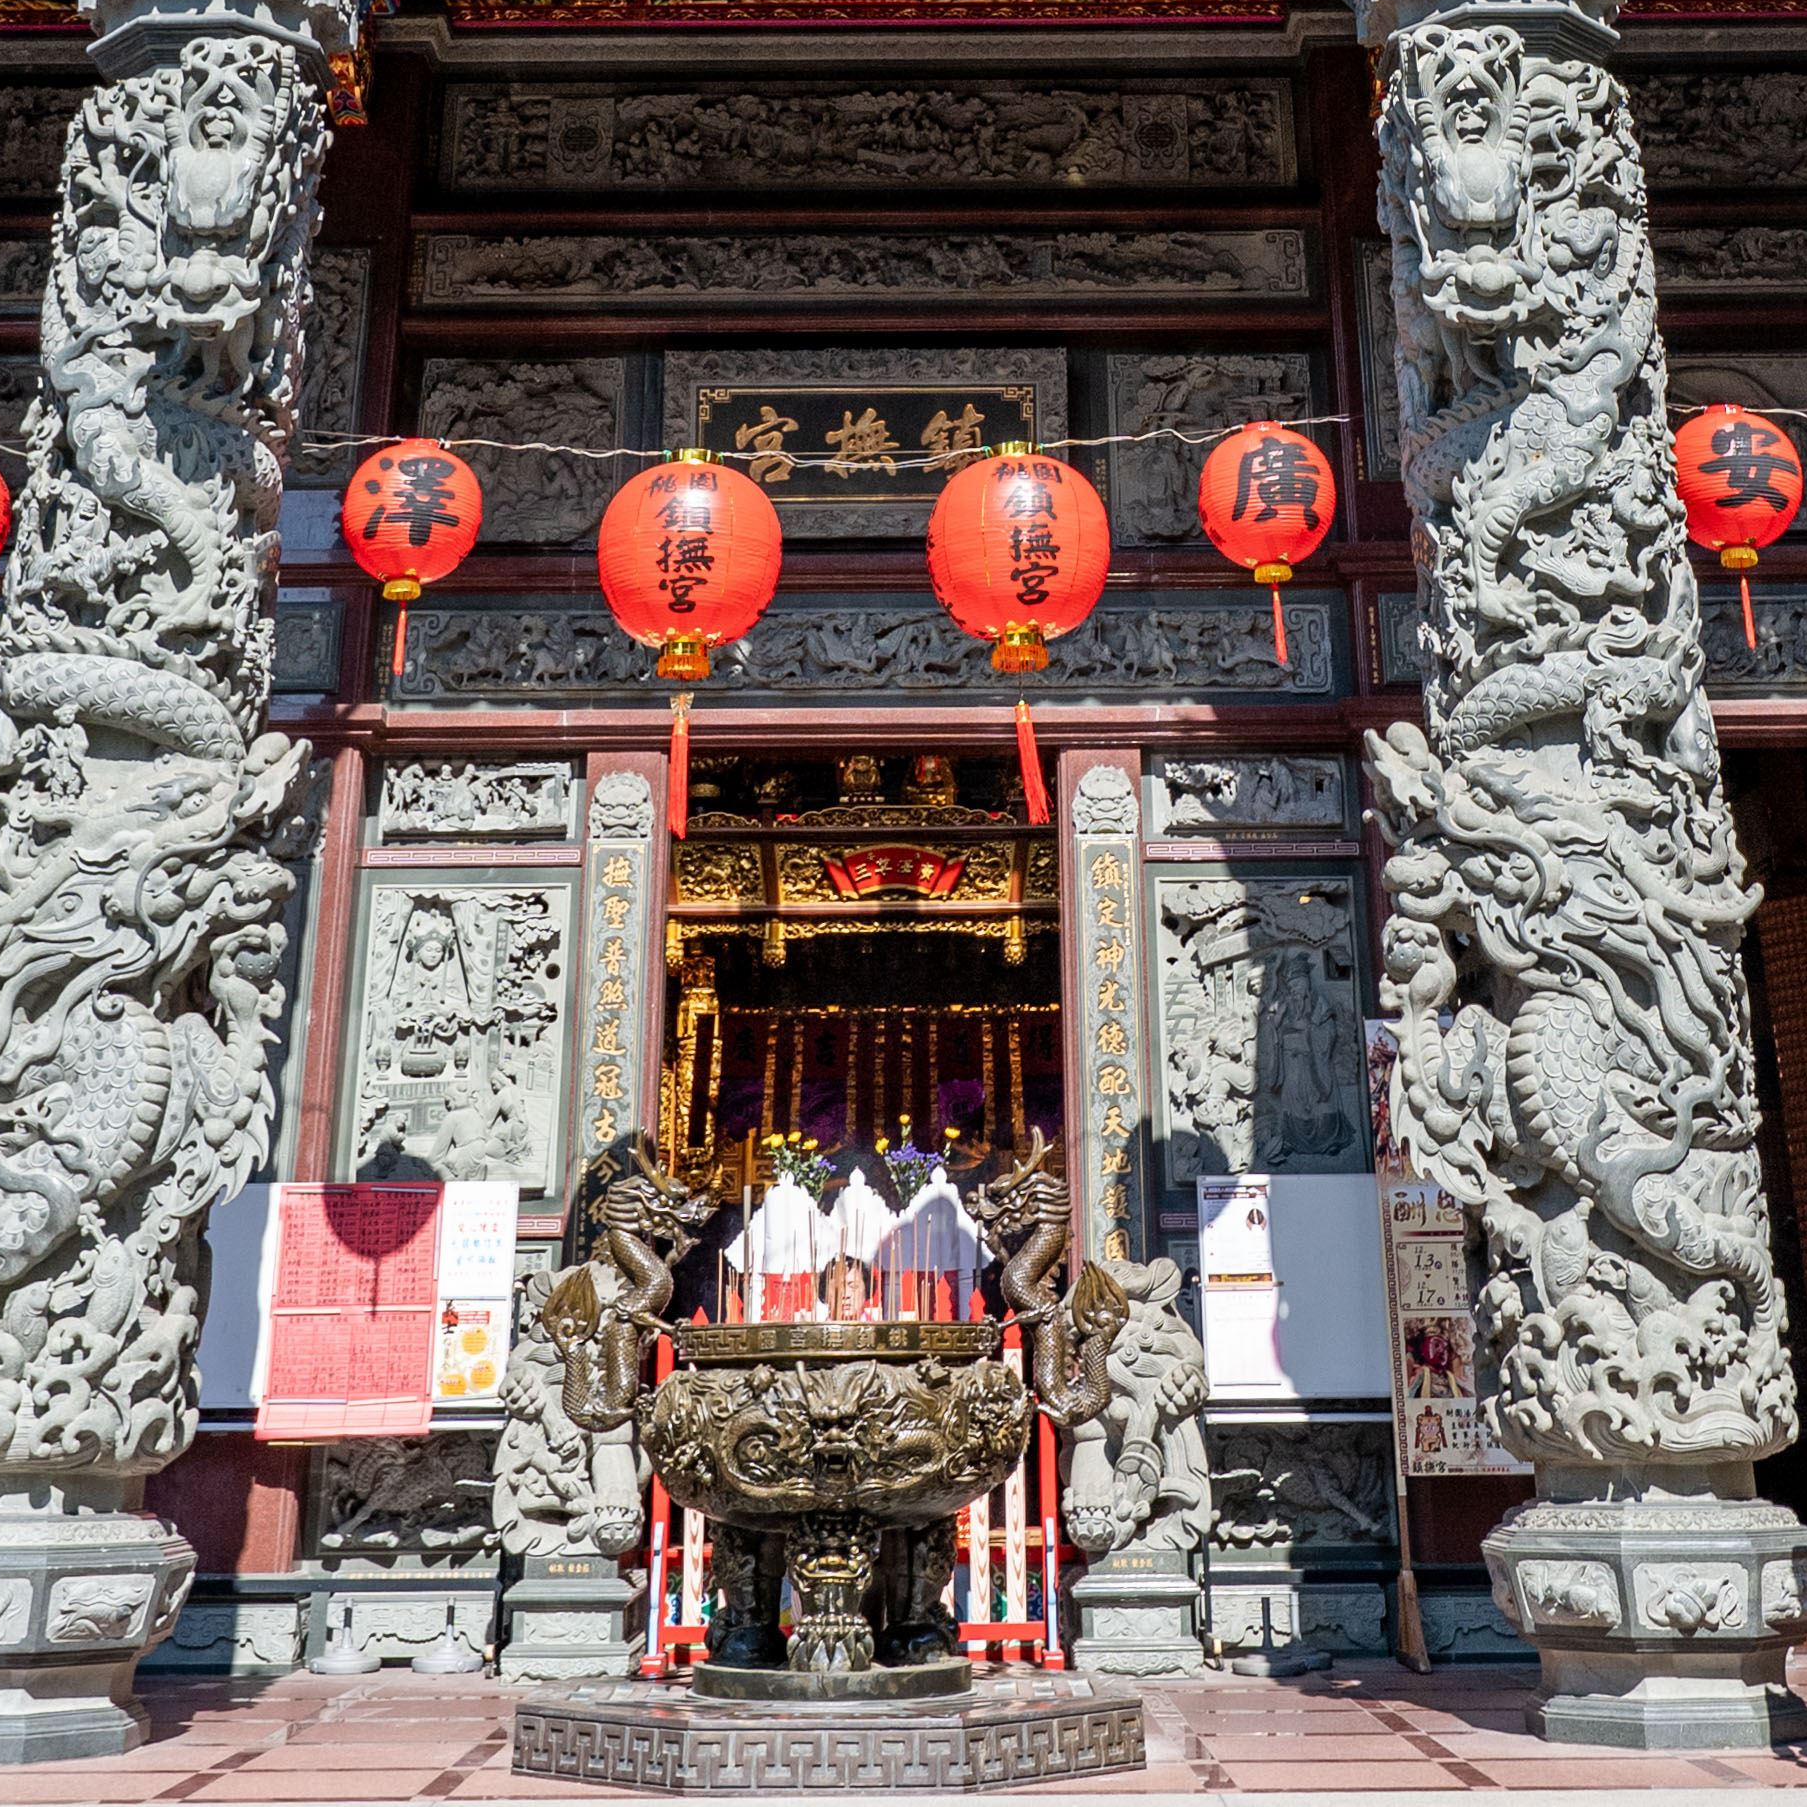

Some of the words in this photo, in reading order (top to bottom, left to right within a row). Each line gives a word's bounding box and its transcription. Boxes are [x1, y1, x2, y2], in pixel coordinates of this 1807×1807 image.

[648, 470, 719, 497] 桃園
[735, 403, 986, 483] 鎮撫宮
[991, 461, 1063, 486] 桃園
[1232, 438, 1320, 530] 廣
[1699, 422, 1798, 512] 安
[363, 455, 460, 546] 澤
[1003, 483, 1061, 606] 鎮撫宮
[655, 495, 715, 614] 鎮撫宮
[588, 856, 633, 1260] 撫聖普照道冠古今
[1414, 1254, 1435, 1268] 13
[1417, 1290, 1436, 1304] 17
